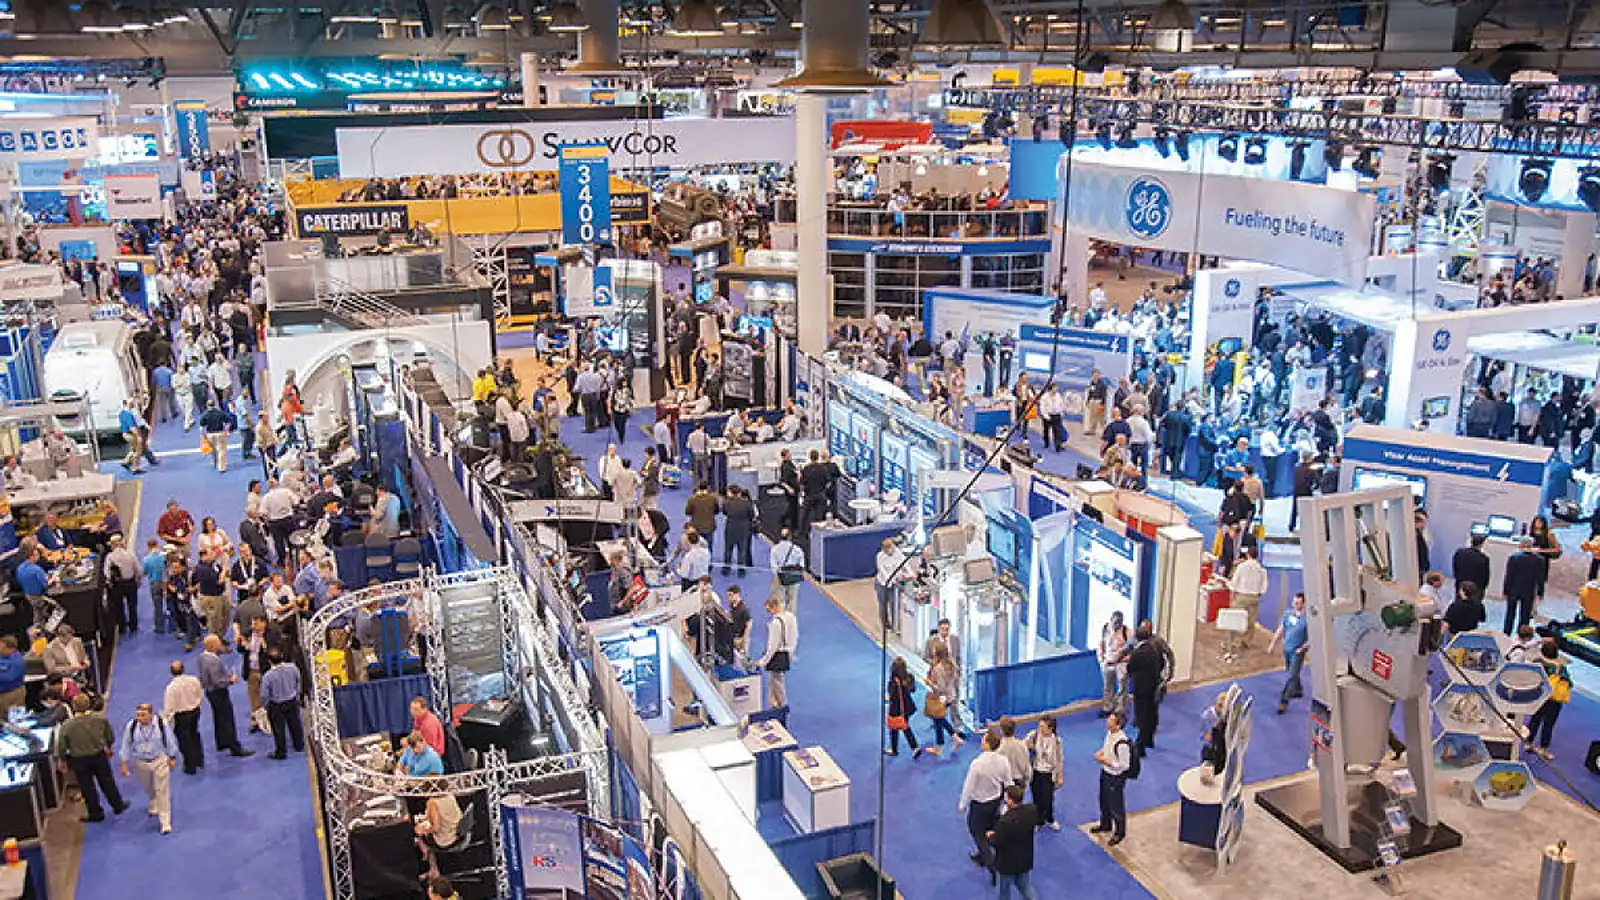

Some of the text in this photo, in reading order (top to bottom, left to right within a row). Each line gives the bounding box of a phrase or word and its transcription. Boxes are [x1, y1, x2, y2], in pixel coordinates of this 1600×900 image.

[248, 97, 297, 107] CAMERON
[543, 132, 677, 159] SWCOR
[577, 165, 595, 241] 3400
[303, 211, 402, 232] CATERPILLAR
[1225, 207, 1345, 247] Fueling the future
